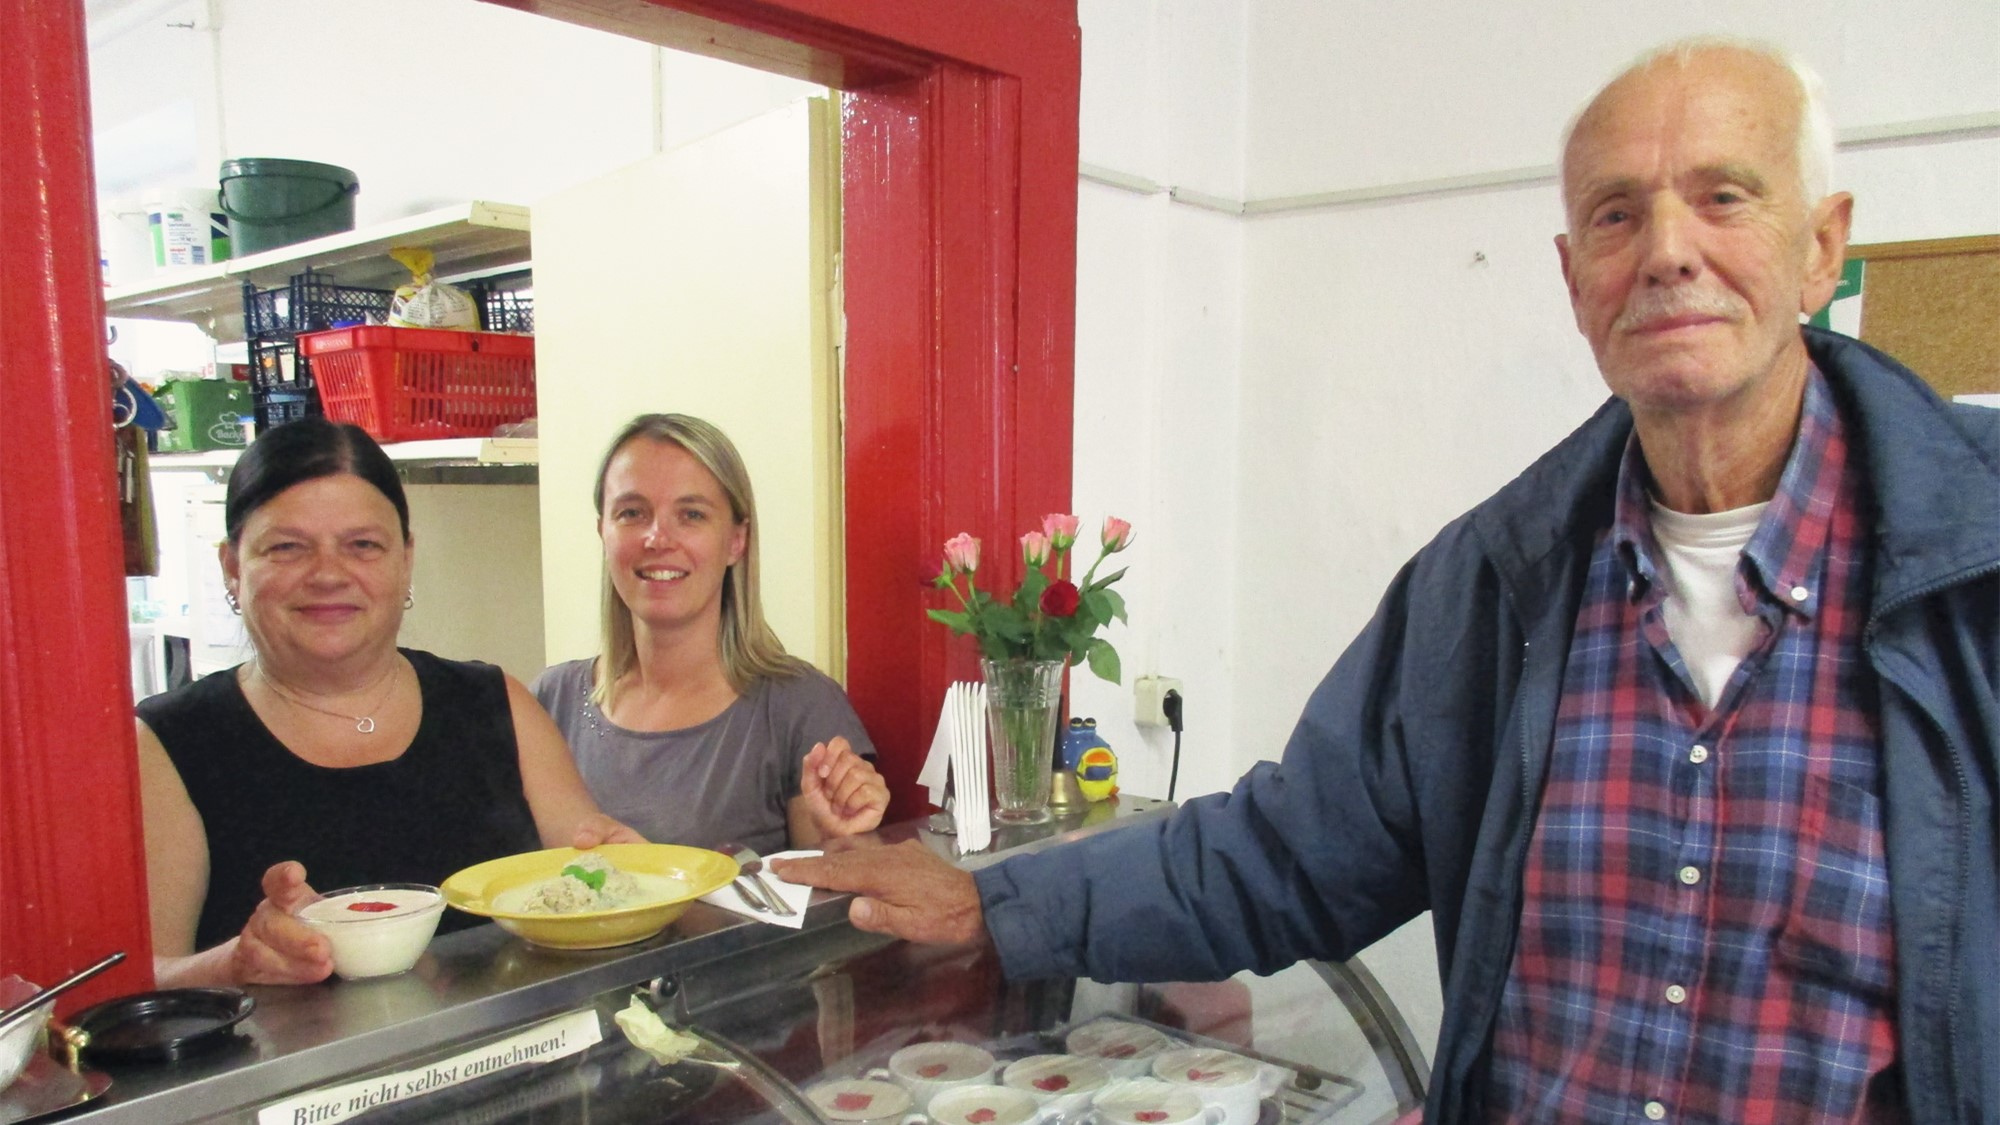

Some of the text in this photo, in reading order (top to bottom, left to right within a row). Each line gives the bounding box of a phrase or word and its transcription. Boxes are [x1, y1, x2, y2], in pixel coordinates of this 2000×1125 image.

[293, 1029, 567, 1125] Bitte nicht selbst entnehmen!
